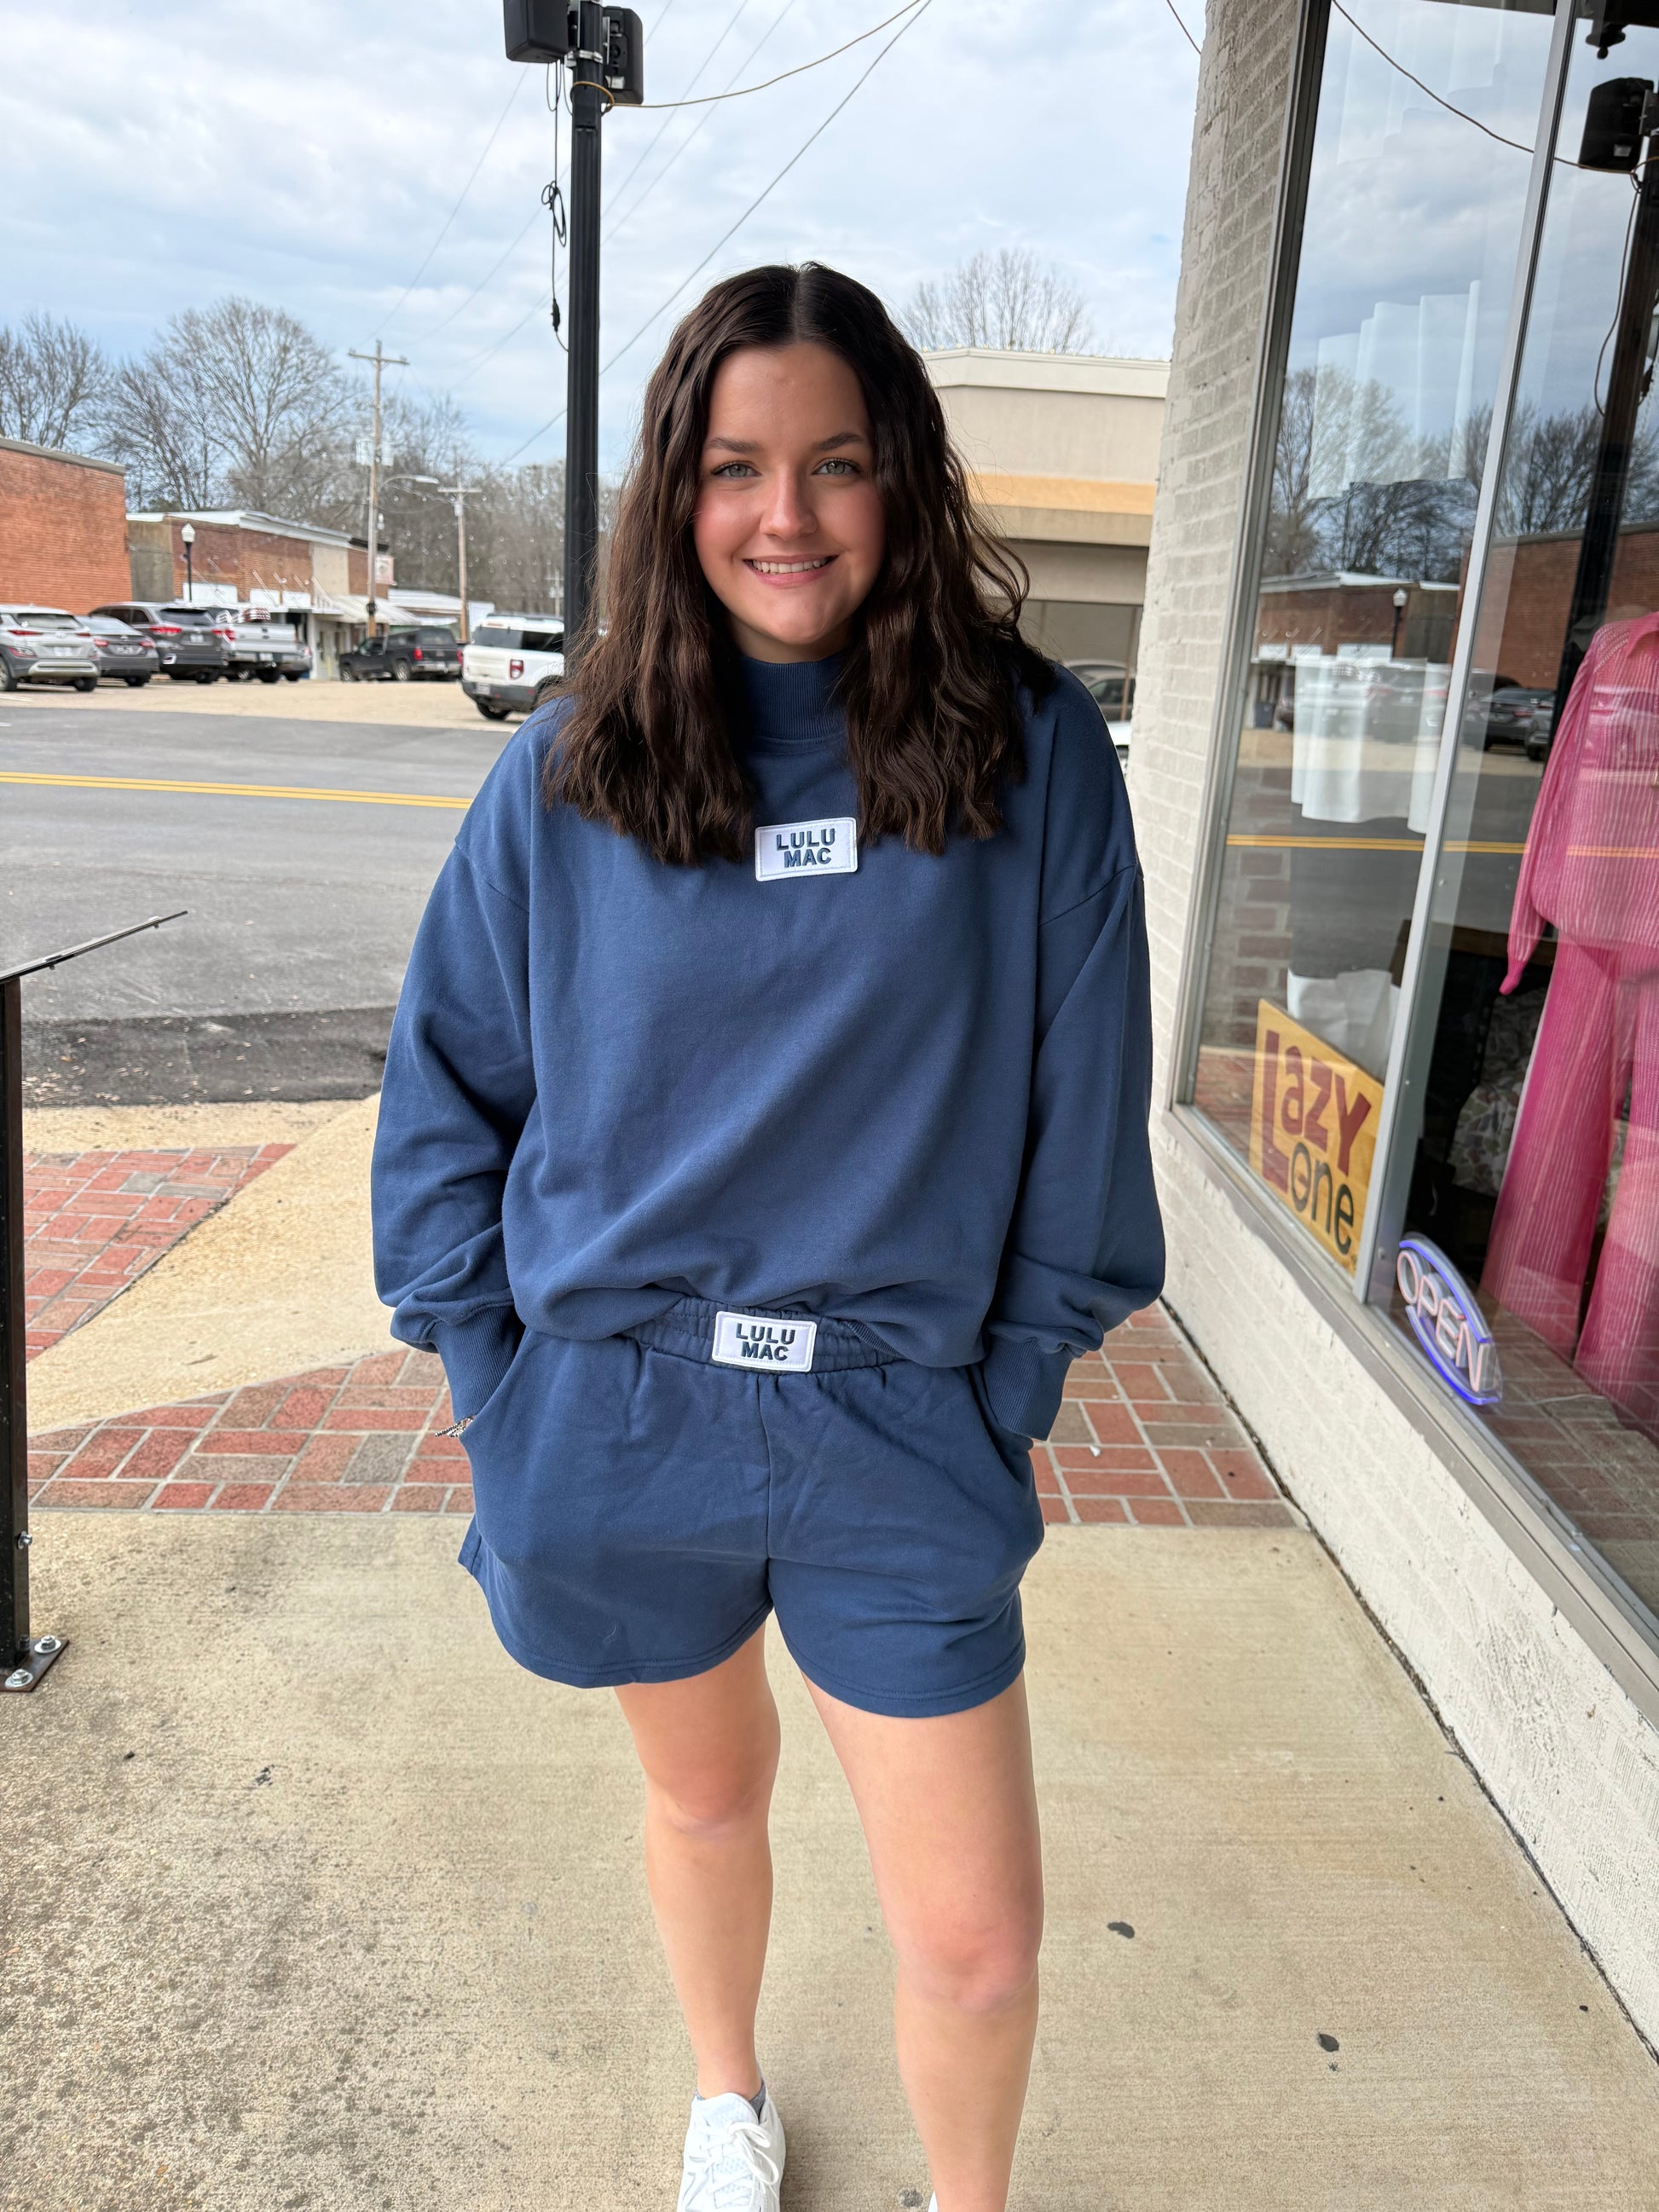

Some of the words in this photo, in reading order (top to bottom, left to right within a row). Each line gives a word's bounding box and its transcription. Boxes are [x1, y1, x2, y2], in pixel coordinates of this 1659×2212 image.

[777, 828, 835, 851] LULU
[784, 847, 831, 868] MAC
[1396, 1250, 1484, 1392] OPEN
[736, 1323, 795, 1344] LULU
[741, 1341, 789, 1360] MAC
